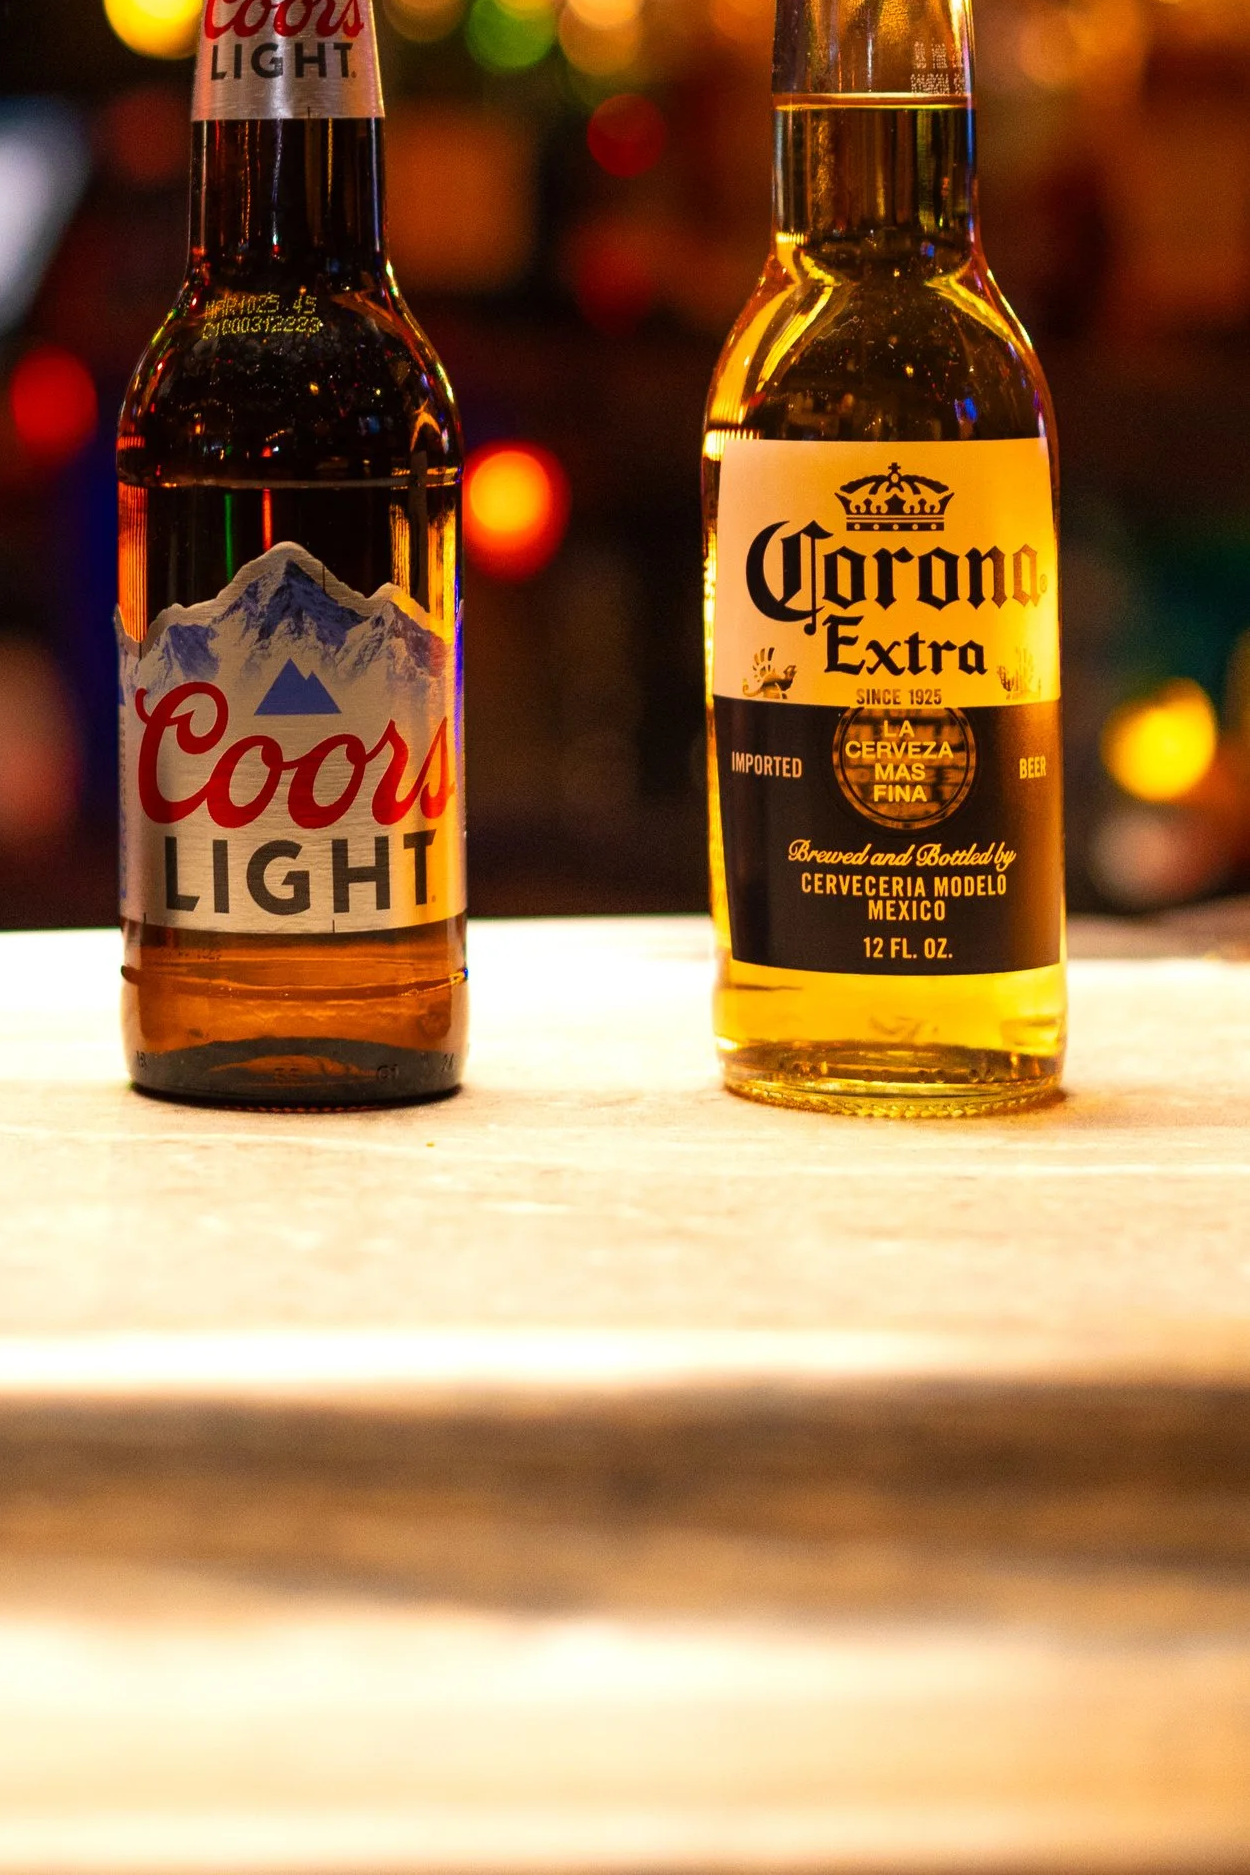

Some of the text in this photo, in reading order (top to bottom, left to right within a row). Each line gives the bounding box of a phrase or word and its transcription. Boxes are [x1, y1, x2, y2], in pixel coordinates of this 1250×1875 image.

[211, 42, 354, 80] LIGHT
[746, 520, 1041, 636] Corona
[822, 614, 988, 676] Extra
[856, 688, 942, 705] SINCE 1925
[884, 720, 915, 738] LA
[135, 681, 454, 829] Coors
[845, 741, 954, 759] CERVEZA
[731, 751, 803, 778] IMPORTED
[874, 763, 926, 781] MAS
[1019, 756, 1047, 779] BEER
[873, 784, 928, 802] FINA
[788, 838, 1017, 872] Brewed and Bottled by
[165, 829, 437, 916] LIGHT
[801, 872, 1007, 897] CERVECERIA MODELO
[868, 900, 947, 921] MEXICO
[863, 937, 953, 959] 12 FL. OZ.
